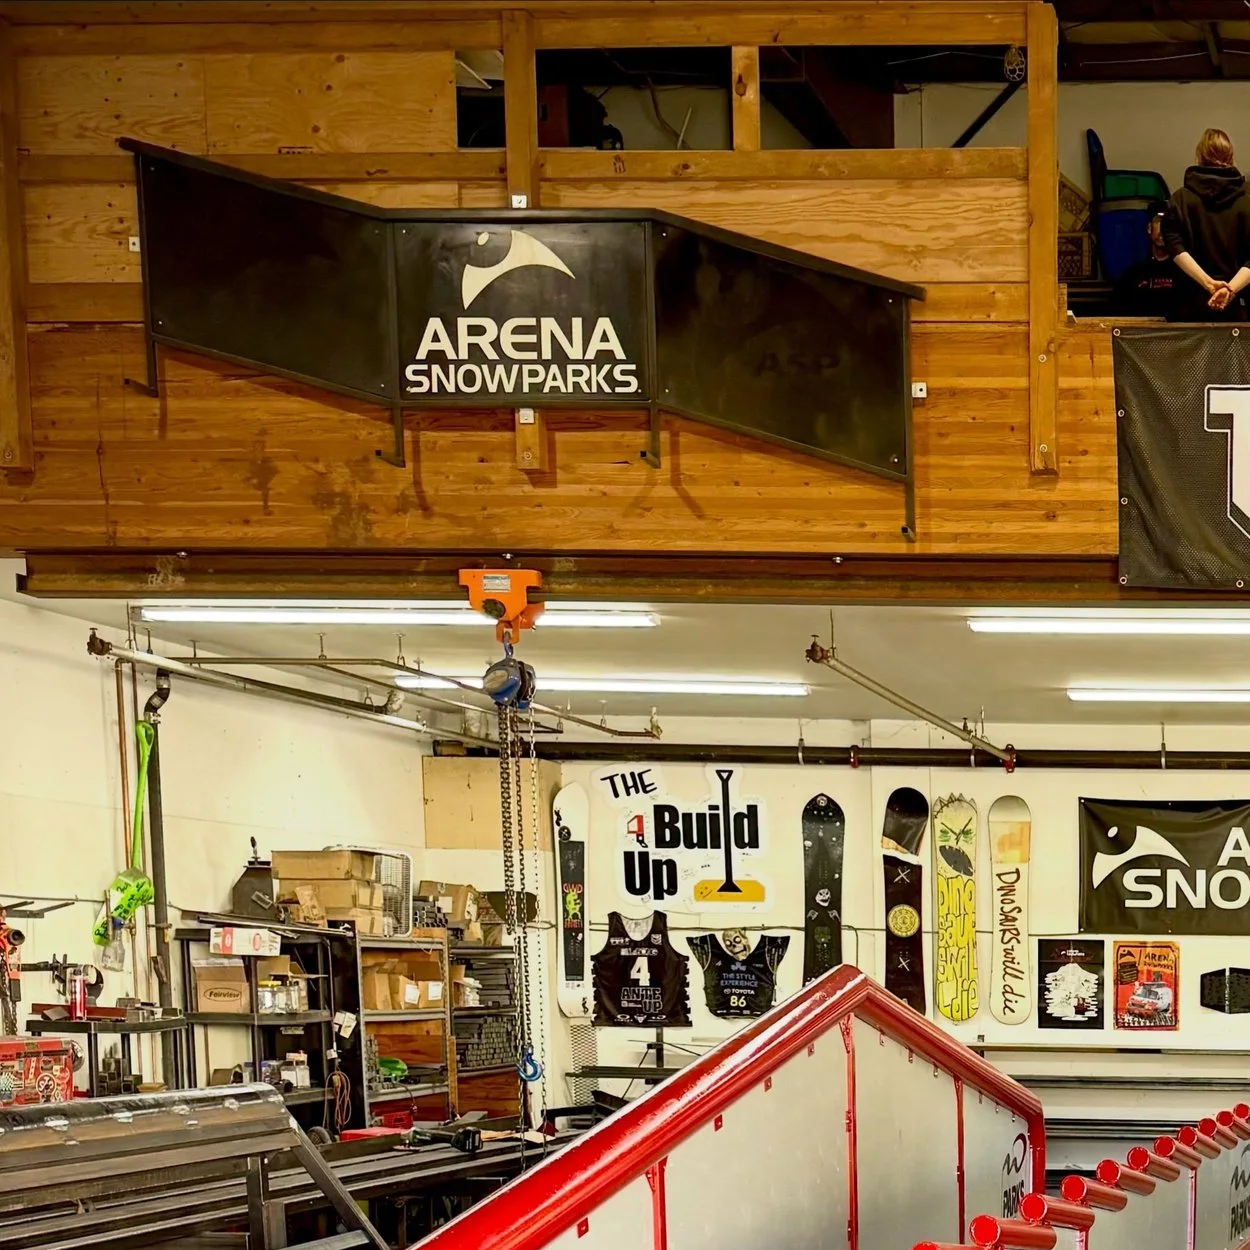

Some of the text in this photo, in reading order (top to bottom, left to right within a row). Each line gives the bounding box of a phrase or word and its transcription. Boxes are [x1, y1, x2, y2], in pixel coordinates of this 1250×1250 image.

[415, 317, 627, 360] ARENA
[405, 364, 639, 393] SNOWPARKS
[600, 769, 657, 799] THE
[653, 804, 760, 850] Build
[623, 851, 678, 901] Up
[630, 956, 651, 987] 4
[1002, 945, 1025, 982] will
[621, 987, 662, 1001] ANTE
[642, 1000, 664, 1014] UP
[730, 995, 747, 1008] 86
[1002, 984, 1026, 1016] die
